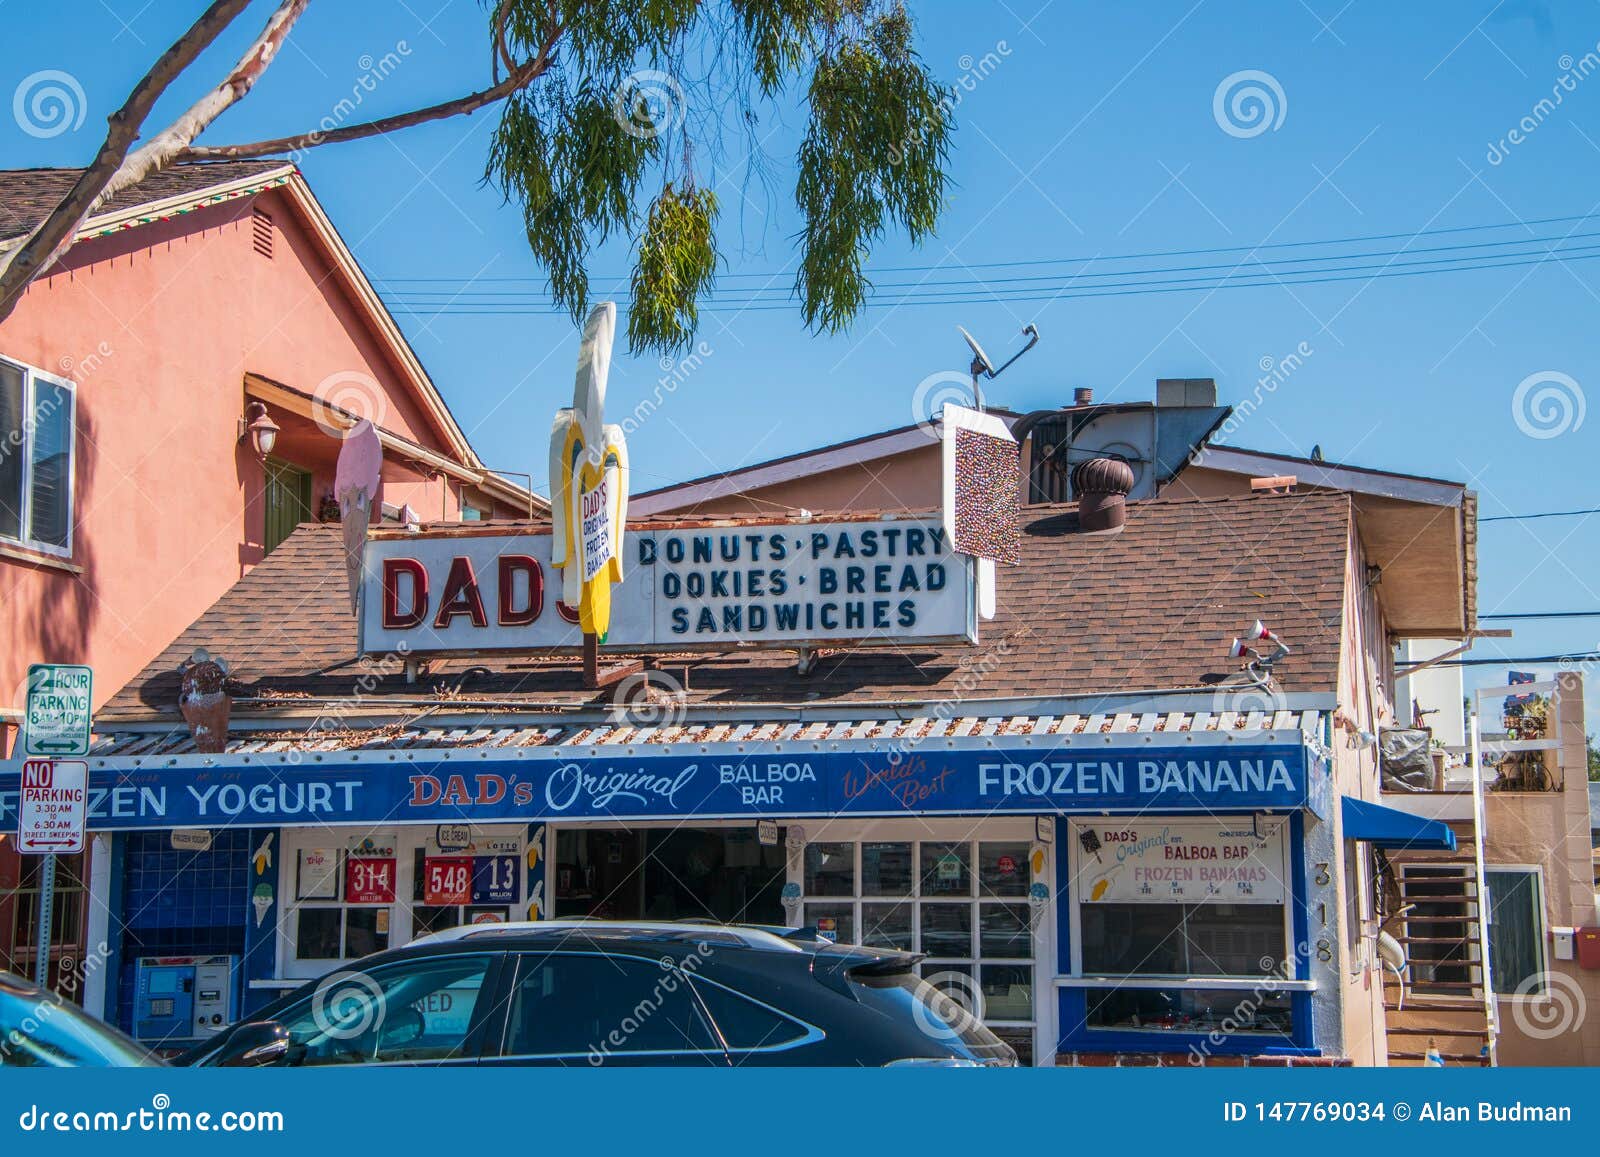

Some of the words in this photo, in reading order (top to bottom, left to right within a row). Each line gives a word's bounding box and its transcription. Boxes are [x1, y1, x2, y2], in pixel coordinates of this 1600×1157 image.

[583, 482, 607, 519] DAD'S
[583, 511, 609, 535] ORIGINAL
[586, 527, 609, 557] FROZEN
[639, 533, 788, 565] DONUTS
[811, 526, 947, 560] PASTRY
[587, 548, 610, 576] BANANA
[819, 563, 947, 595] BREAD
[671, 599, 917, 633] SANDWICHES
[29, 668, 50, 691] 2
[55, 674, 88, 688] HOUR
[31, 695, 87, 710] PARKING
[26, 763, 51, 787] NO
[720, 762, 817, 784] BALBOA
[844, 755, 927, 798] World's
[891, 766, 957, 807] Best
[978, 762, 1125, 796] FROZEN
[1138, 760, 1297, 793] BANANA
[26, 789, 82, 802] PARKING
[409, 774, 533, 806] DAD's
[545, 763, 698, 811] Original
[742, 786, 784, 805] BAR
[0, 785, 166, 821] FZEN
[186, 781, 363, 817] YOGURT
[58, 804, 72, 812] AM
[57, 821, 71, 829] AM
[441, 831, 450, 840] ICE
[760, 825, 777, 839] COOKIES
[1104, 830, 1138, 842] DAD'S
[1116, 827, 1170, 861] Original
[1164, 846, 1217, 860] BALBOA
[1223, 846, 1249, 860] BAR
[353, 863, 389, 891] 314
[431, 866, 467, 893] 548
[489, 858, 514, 889] 13
[1134, 867, 1192, 880] FROZEN
[1199, 867, 1266, 881] BANANAS
